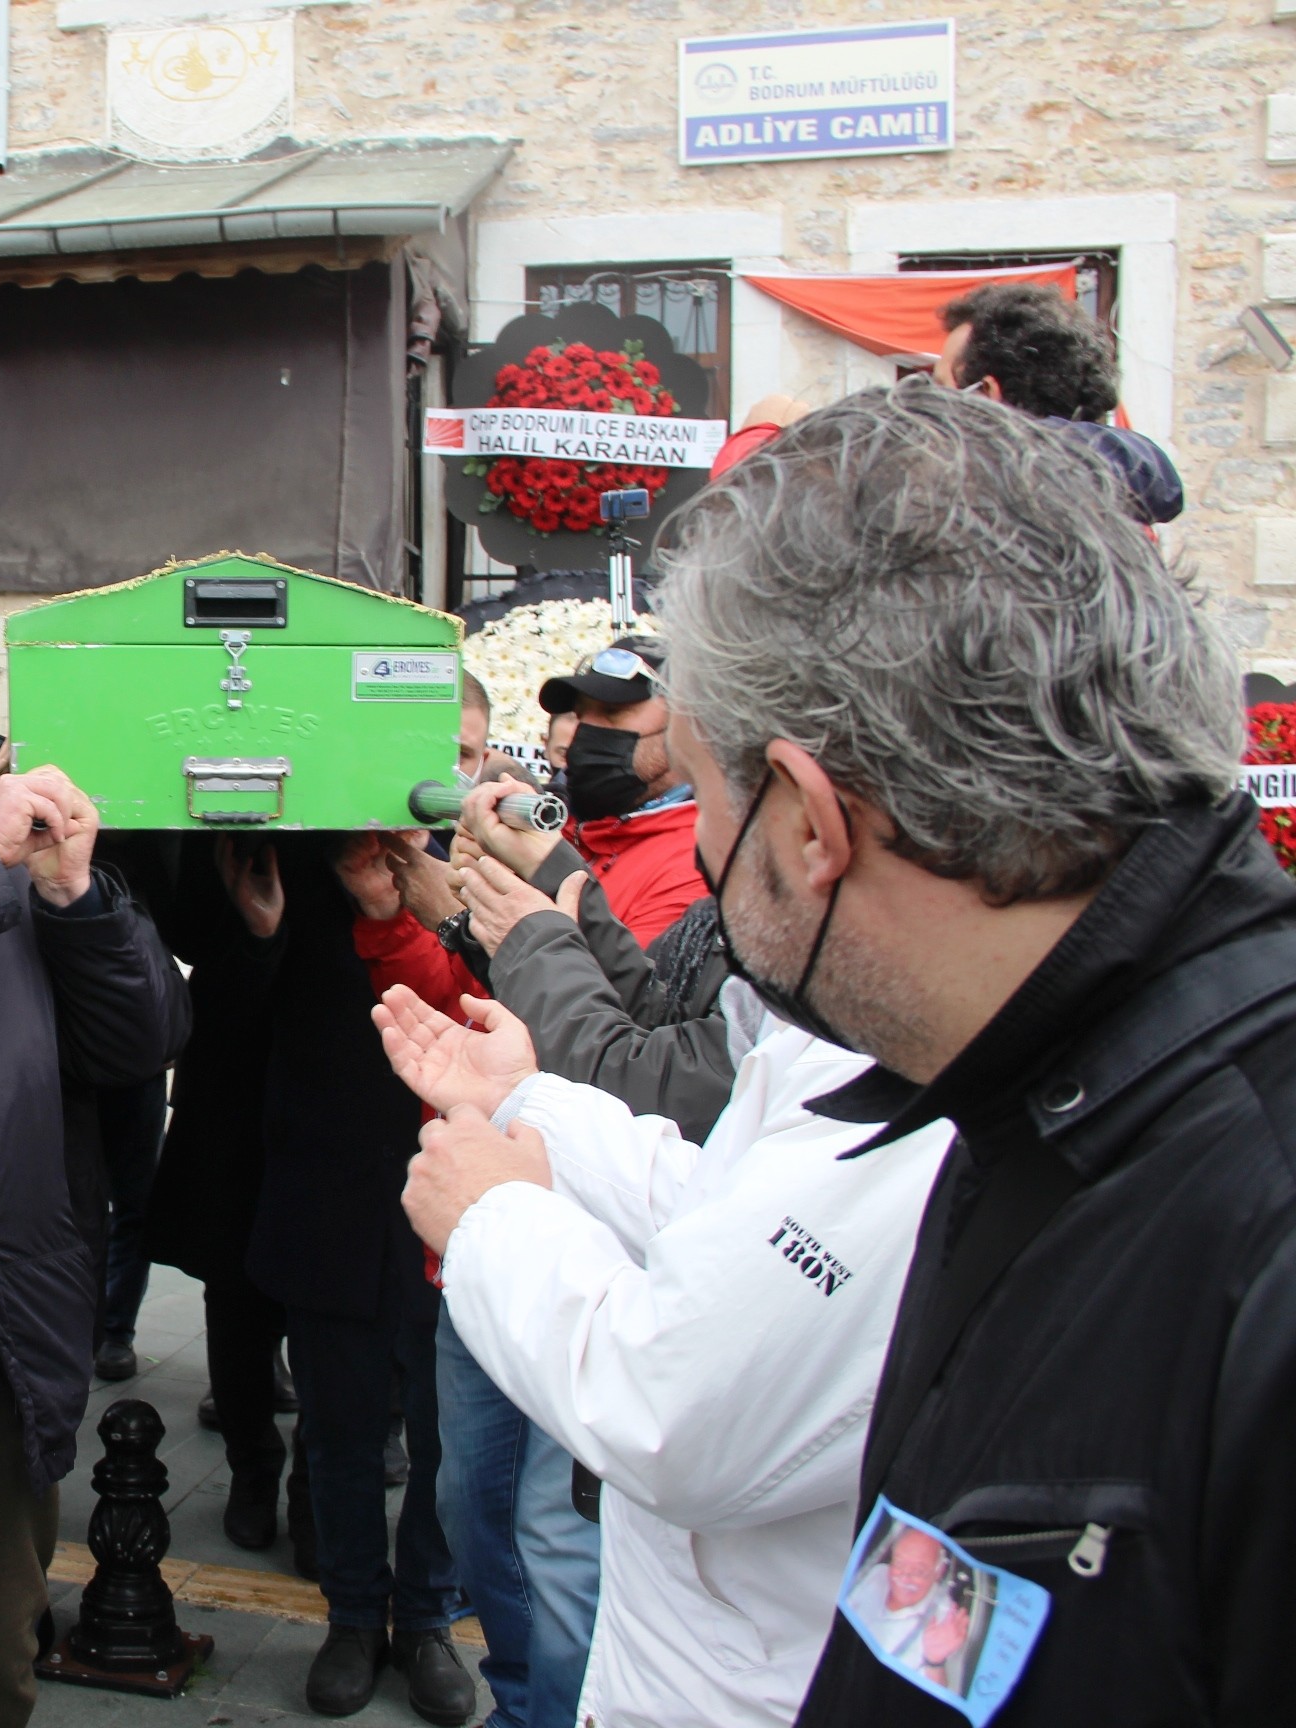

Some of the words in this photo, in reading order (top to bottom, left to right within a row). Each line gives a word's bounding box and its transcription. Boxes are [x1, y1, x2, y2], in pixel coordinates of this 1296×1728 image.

[750, 82, 825, 101] BODRUM
[830, 71, 939, 95] MÜFTÜLÜĞÜ
[695, 116, 819, 148] ADLİYE
[830, 106, 940, 139] CAMİİ
[470, 413, 497, 433] CHP
[501, 414, 573, 435] BODRUM
[579, 413, 618, 440] İLÇE
[625, 420, 697, 444] BAŞKANI
[478, 435, 546, 455] HALİL
[556, 438, 686, 464] KARAHAN
[782, 1215, 822, 1252] SOUTH
[822, 1251, 854, 1281] WEST
